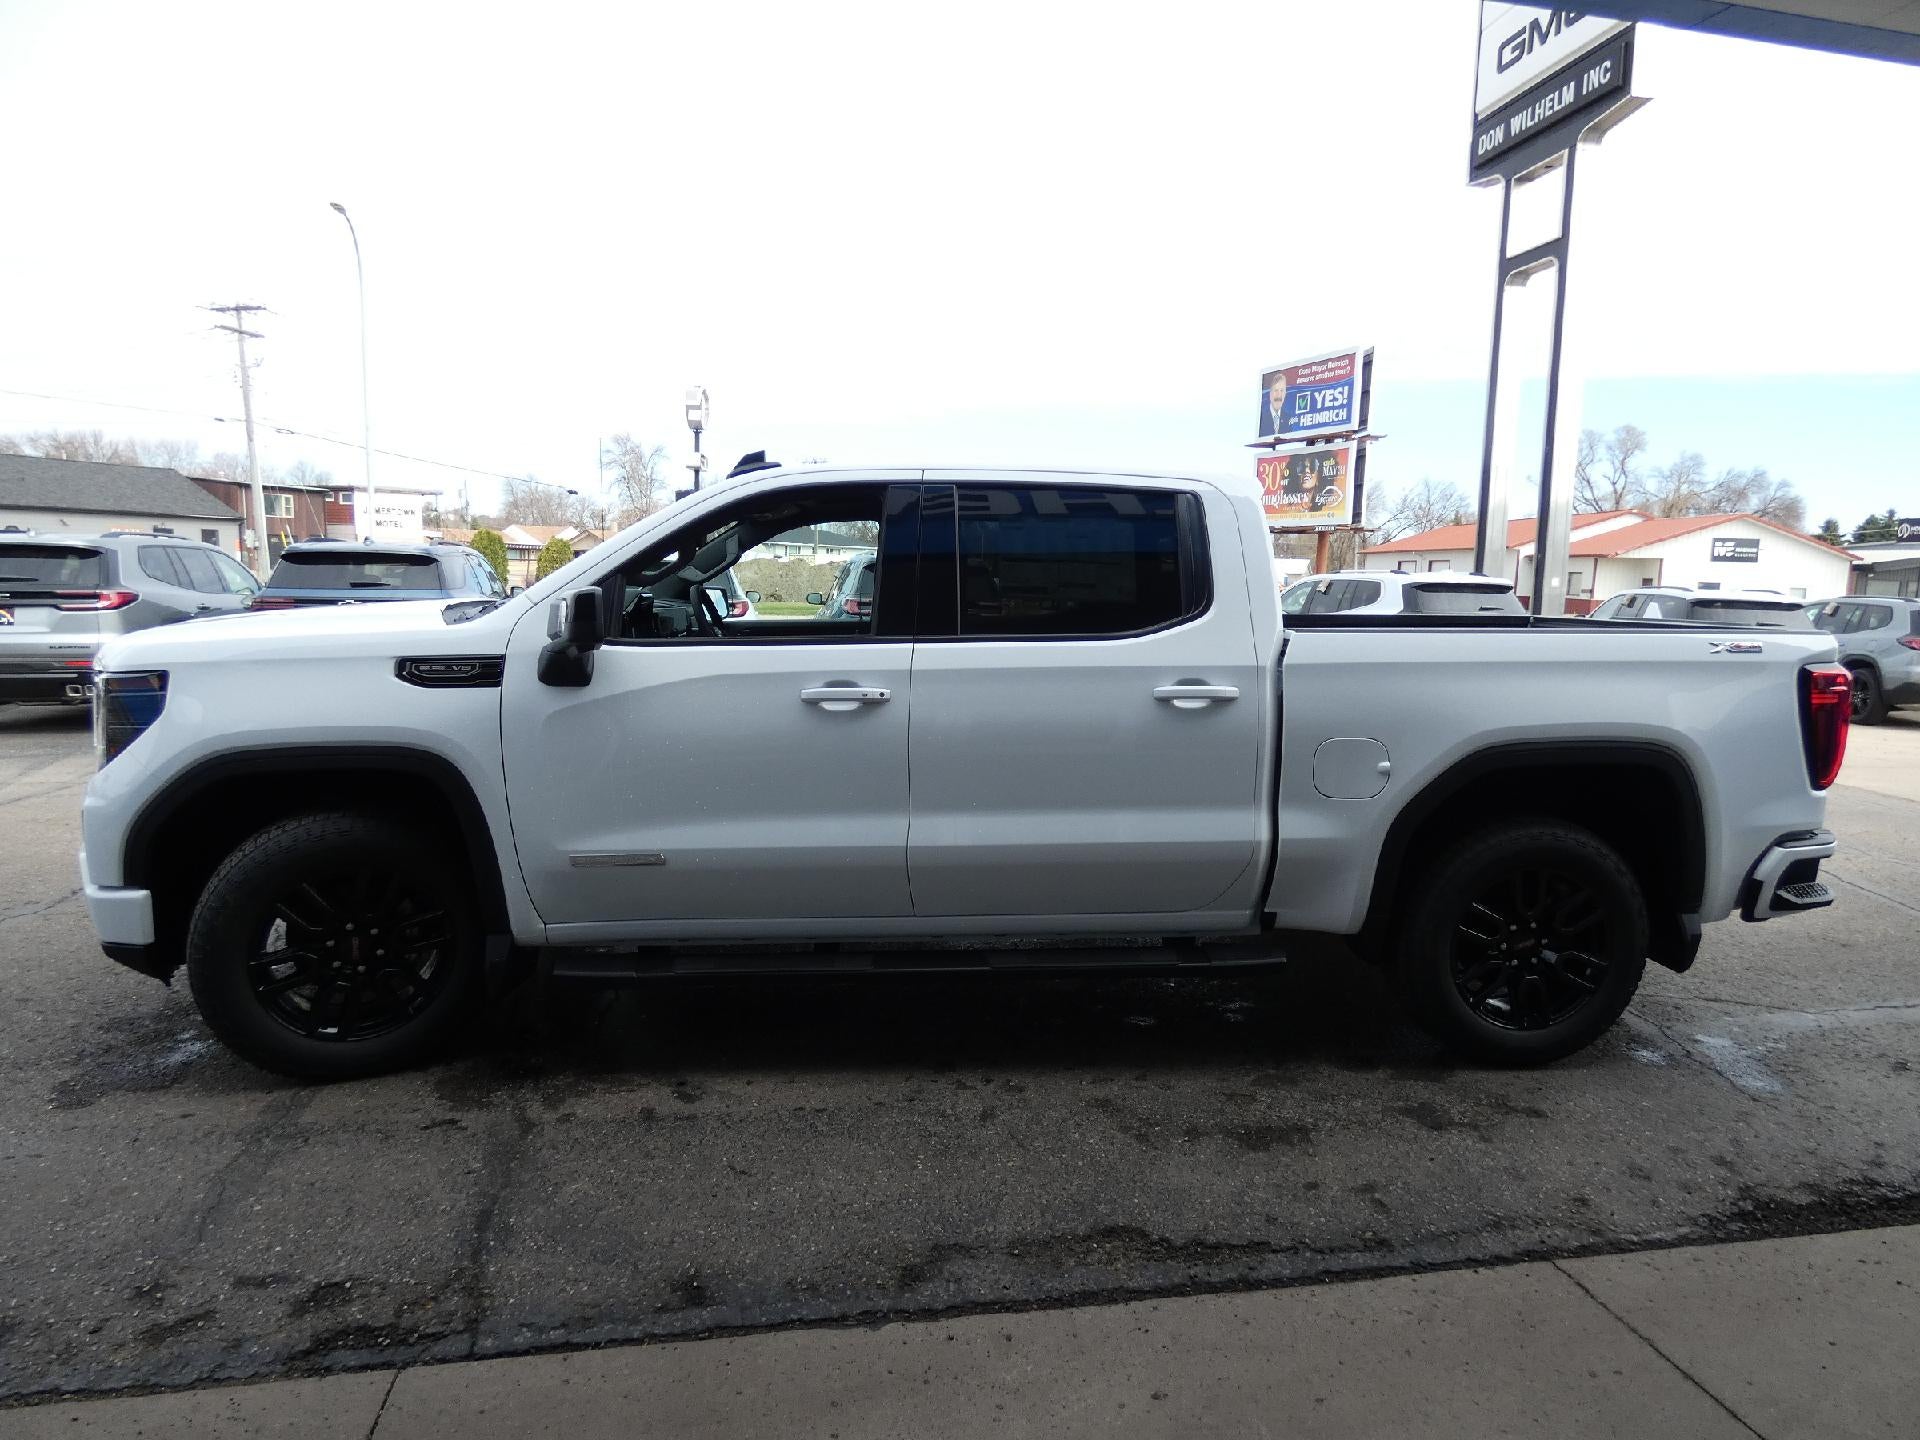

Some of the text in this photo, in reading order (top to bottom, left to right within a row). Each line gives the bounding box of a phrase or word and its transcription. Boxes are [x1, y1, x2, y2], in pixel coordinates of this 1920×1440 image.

[1478, 60, 1612, 156] DON WILHELM INC
[1314, 386, 1349, 409] YES!
[1300, 408, 1347, 426] HEINRICH
[1322, 465, 1336, 477] MAY
[1262, 490, 1310, 508] unglasses
[363, 506, 417, 516] JMESTOWN
[375, 519, 404, 529] MOTEL
